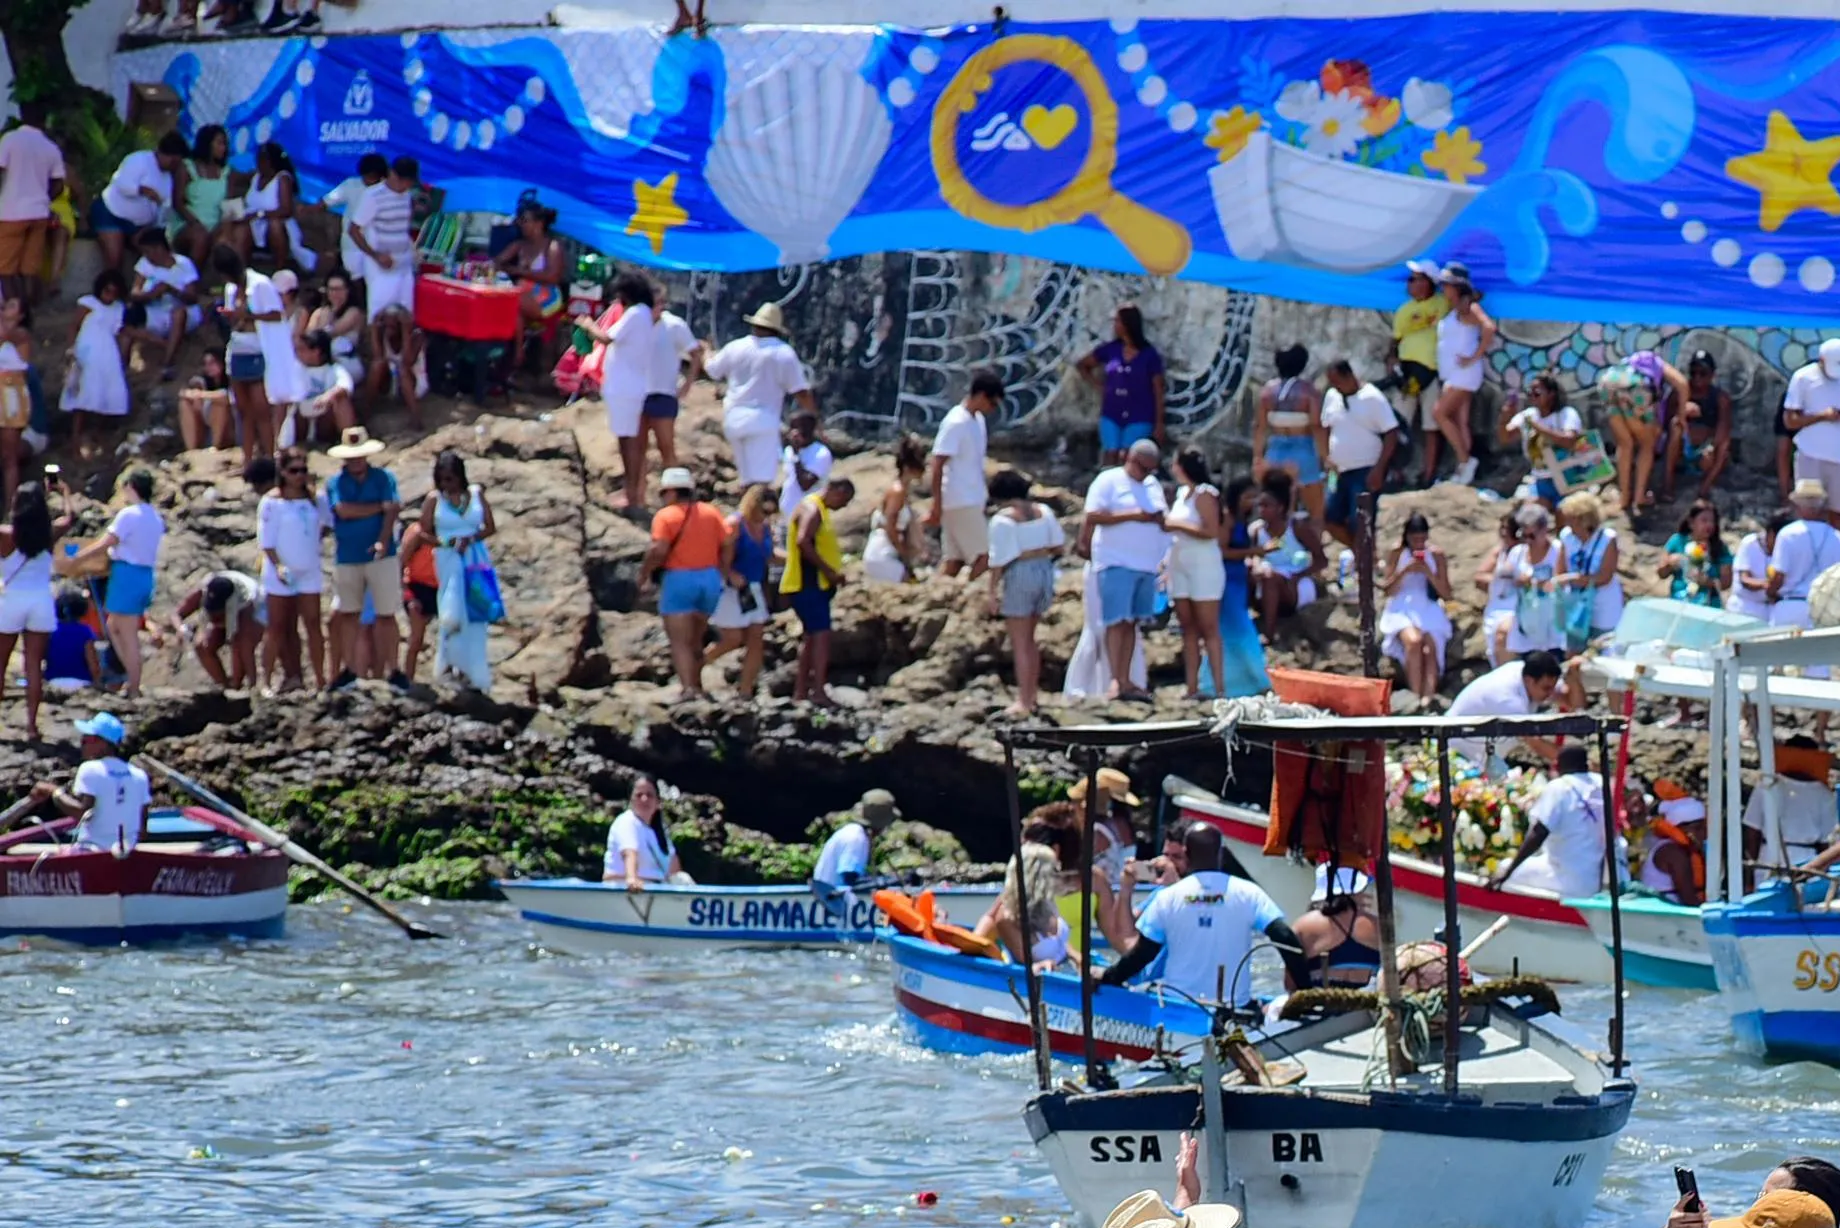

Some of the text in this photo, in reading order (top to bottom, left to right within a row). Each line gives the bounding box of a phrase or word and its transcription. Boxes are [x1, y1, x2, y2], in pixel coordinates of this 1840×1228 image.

[319, 119, 390, 143] SALVADOR
[1090, 1132, 1324, 1163] SSA BA
